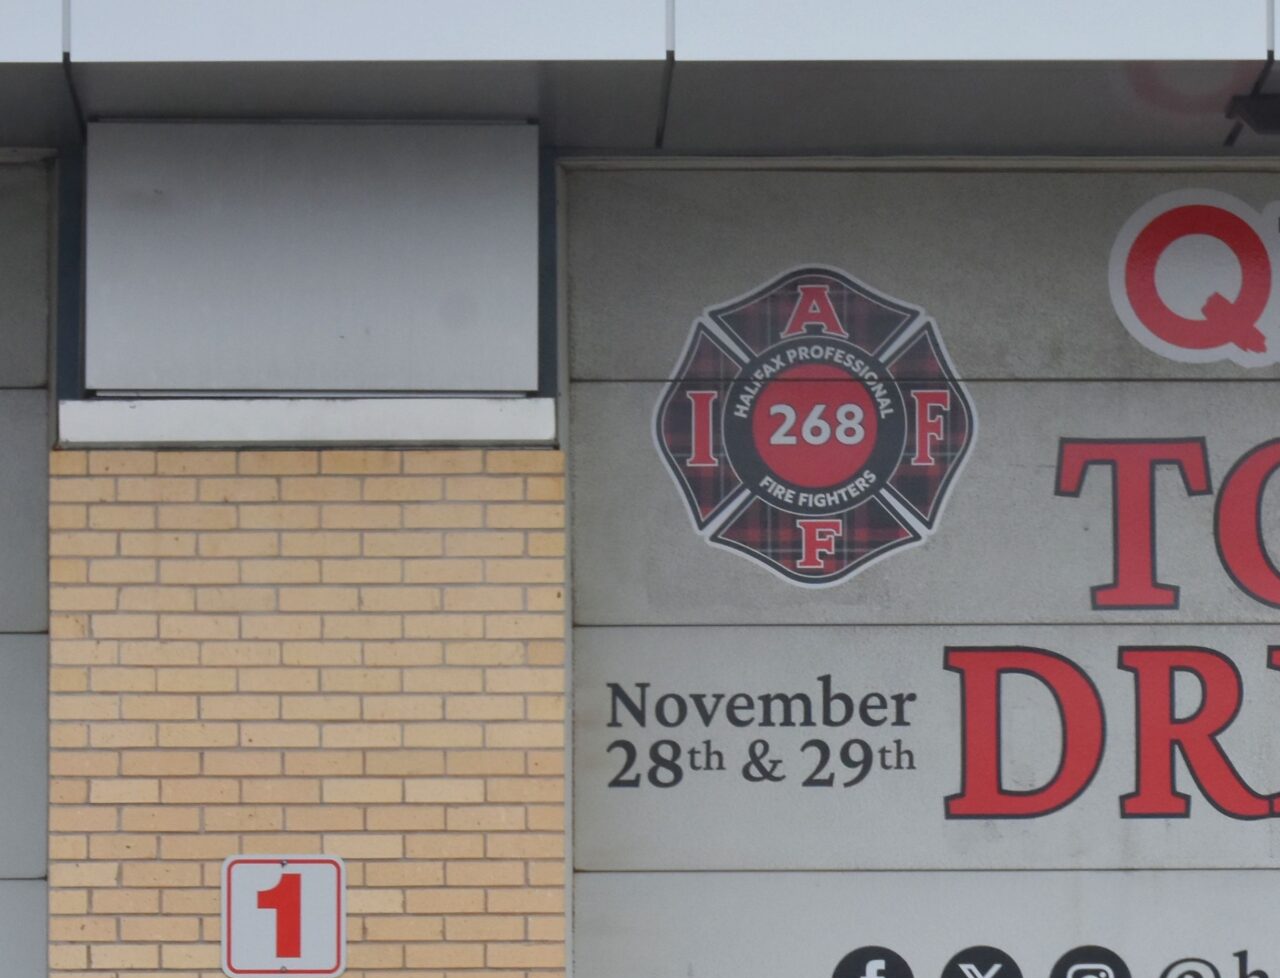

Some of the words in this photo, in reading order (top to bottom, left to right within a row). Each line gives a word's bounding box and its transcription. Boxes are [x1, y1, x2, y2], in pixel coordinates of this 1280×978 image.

[780, 284, 849, 339] A
[734, 355, 787, 419] HALIFAX
[787, 345, 895, 420] PROFESSIONAL
[686, 390, 719, 467] I
[769, 404, 865, 445] 268
[911, 390, 950, 466] F
[759, 475, 796, 504] FIRE
[798, 470, 877, 507] FIGHTERS
[796, 519, 842, 569] F
[606, 674, 917, 728] November
[606, 739, 726, 788] 28th
[742, 739, 786, 782] &
[800, 738, 917, 788] 29th
[257, 873, 302, 958] 1
